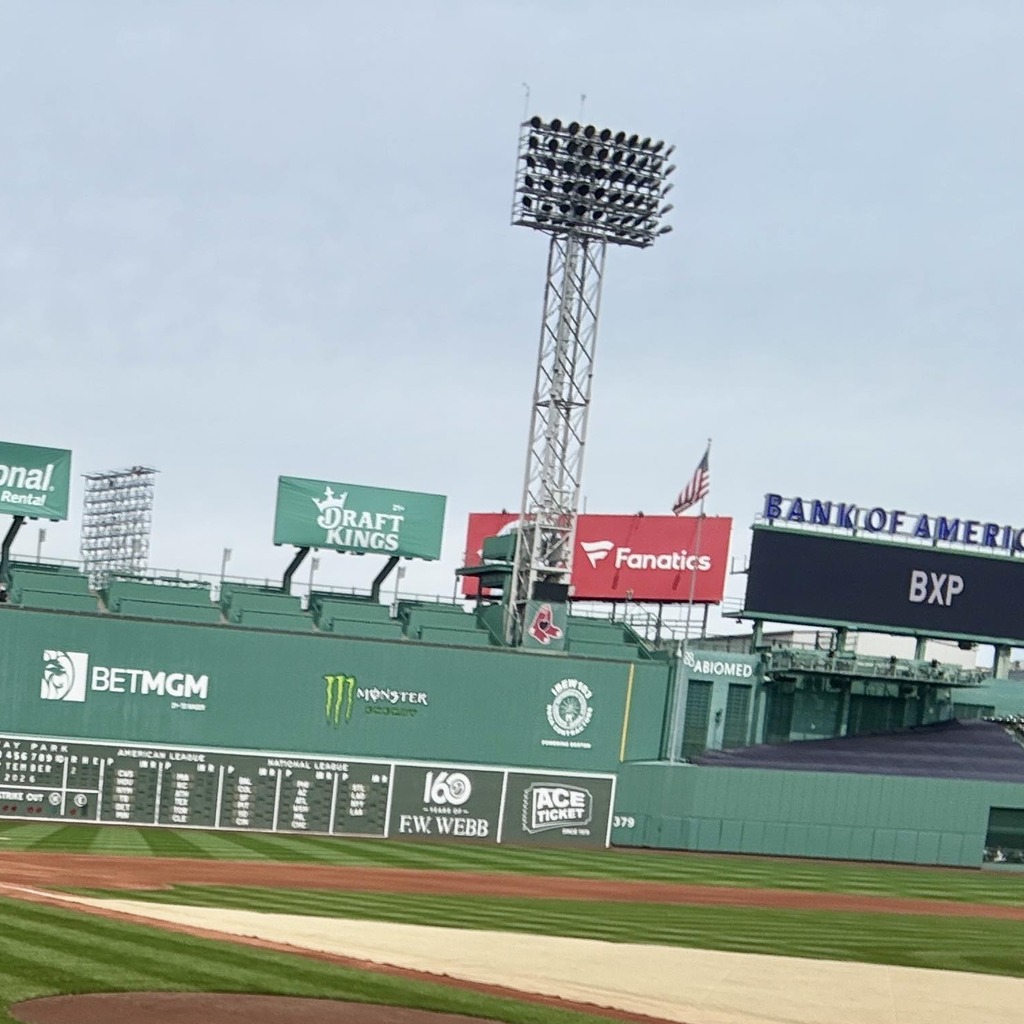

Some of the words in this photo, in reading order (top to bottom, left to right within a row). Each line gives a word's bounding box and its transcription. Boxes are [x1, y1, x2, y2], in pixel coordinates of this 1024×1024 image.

[1, 490, 47, 507] Rental
[317, 506, 405, 533] DRAFT
[763, 493, 857, 529] BANK
[864, 508, 907, 534] OF
[326, 526, 399, 551] KINGS
[615, 547, 711, 571] Fanatics
[908, 570, 964, 606] BXP
[693, 661, 753, 679] ABIOMED
[91, 666, 209, 699] BETMGM
[356, 687, 428, 705] MONSTER
[30, 742, 69, 754] PARK
[267, 758, 311, 770] NATIONAL
[314, 761, 349, 772] LEAGUE
[423, 771, 472, 806] 160
[536, 788, 585, 809] ACE
[536, 808, 585, 823] TICKET
[613, 816, 636, 829] 379
[436, 817, 489, 837] WEBB
